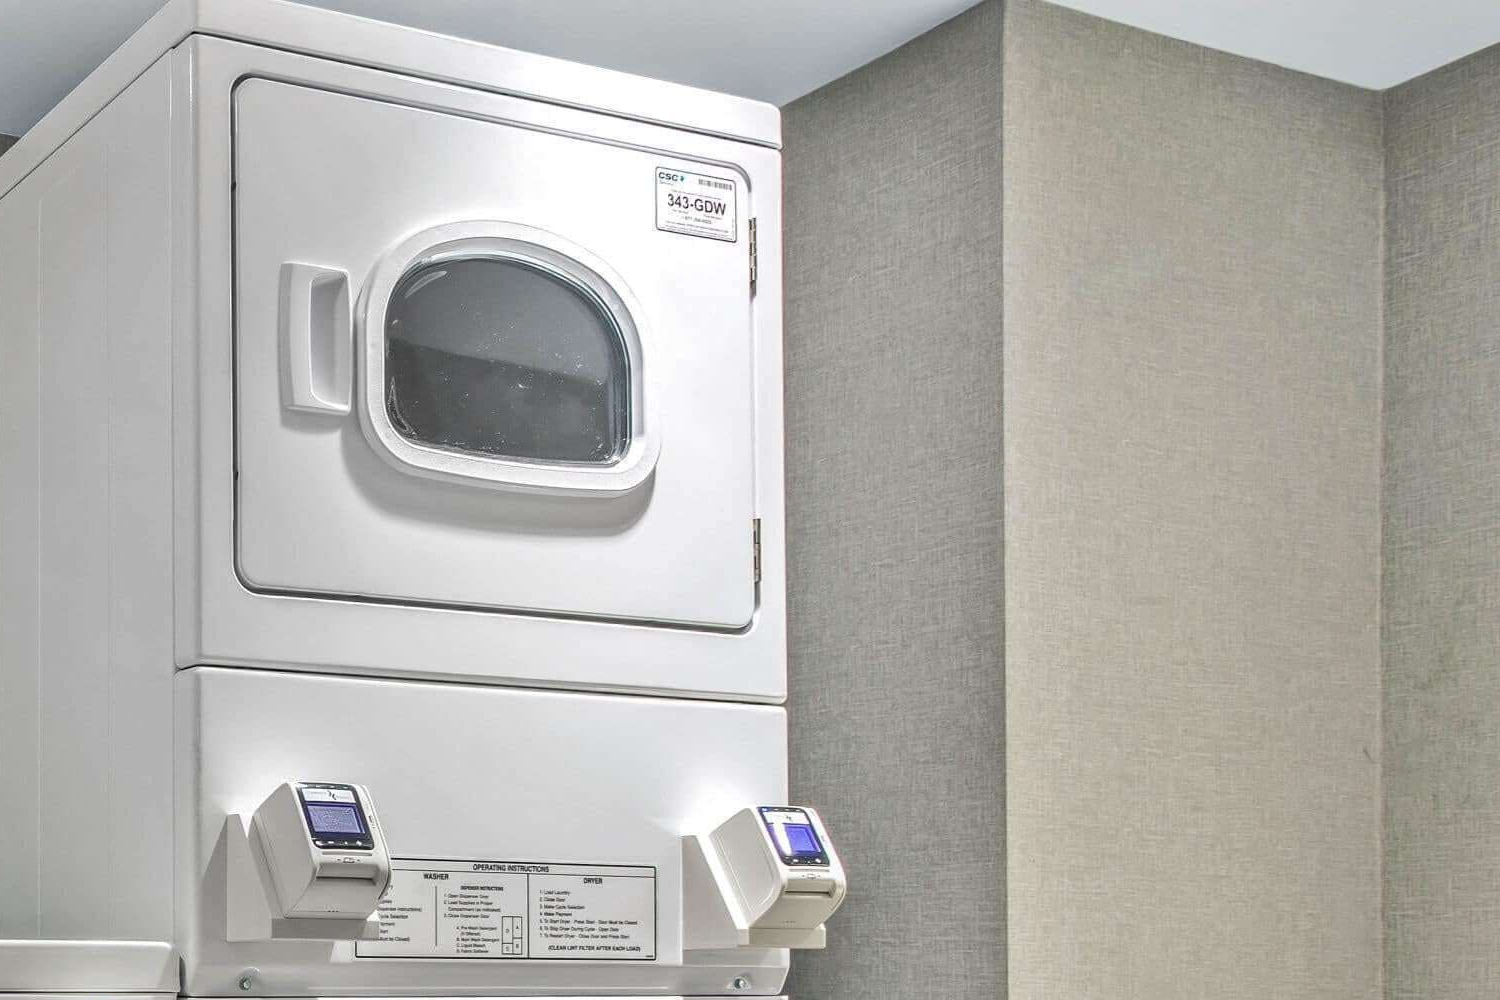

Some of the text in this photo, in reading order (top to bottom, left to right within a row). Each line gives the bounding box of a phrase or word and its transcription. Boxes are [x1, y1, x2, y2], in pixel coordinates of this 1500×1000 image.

[658, 172, 678, 182] CSC
[668, 194, 726, 215] 343-GDW
[473, 864, 506, 872] OPERATING
